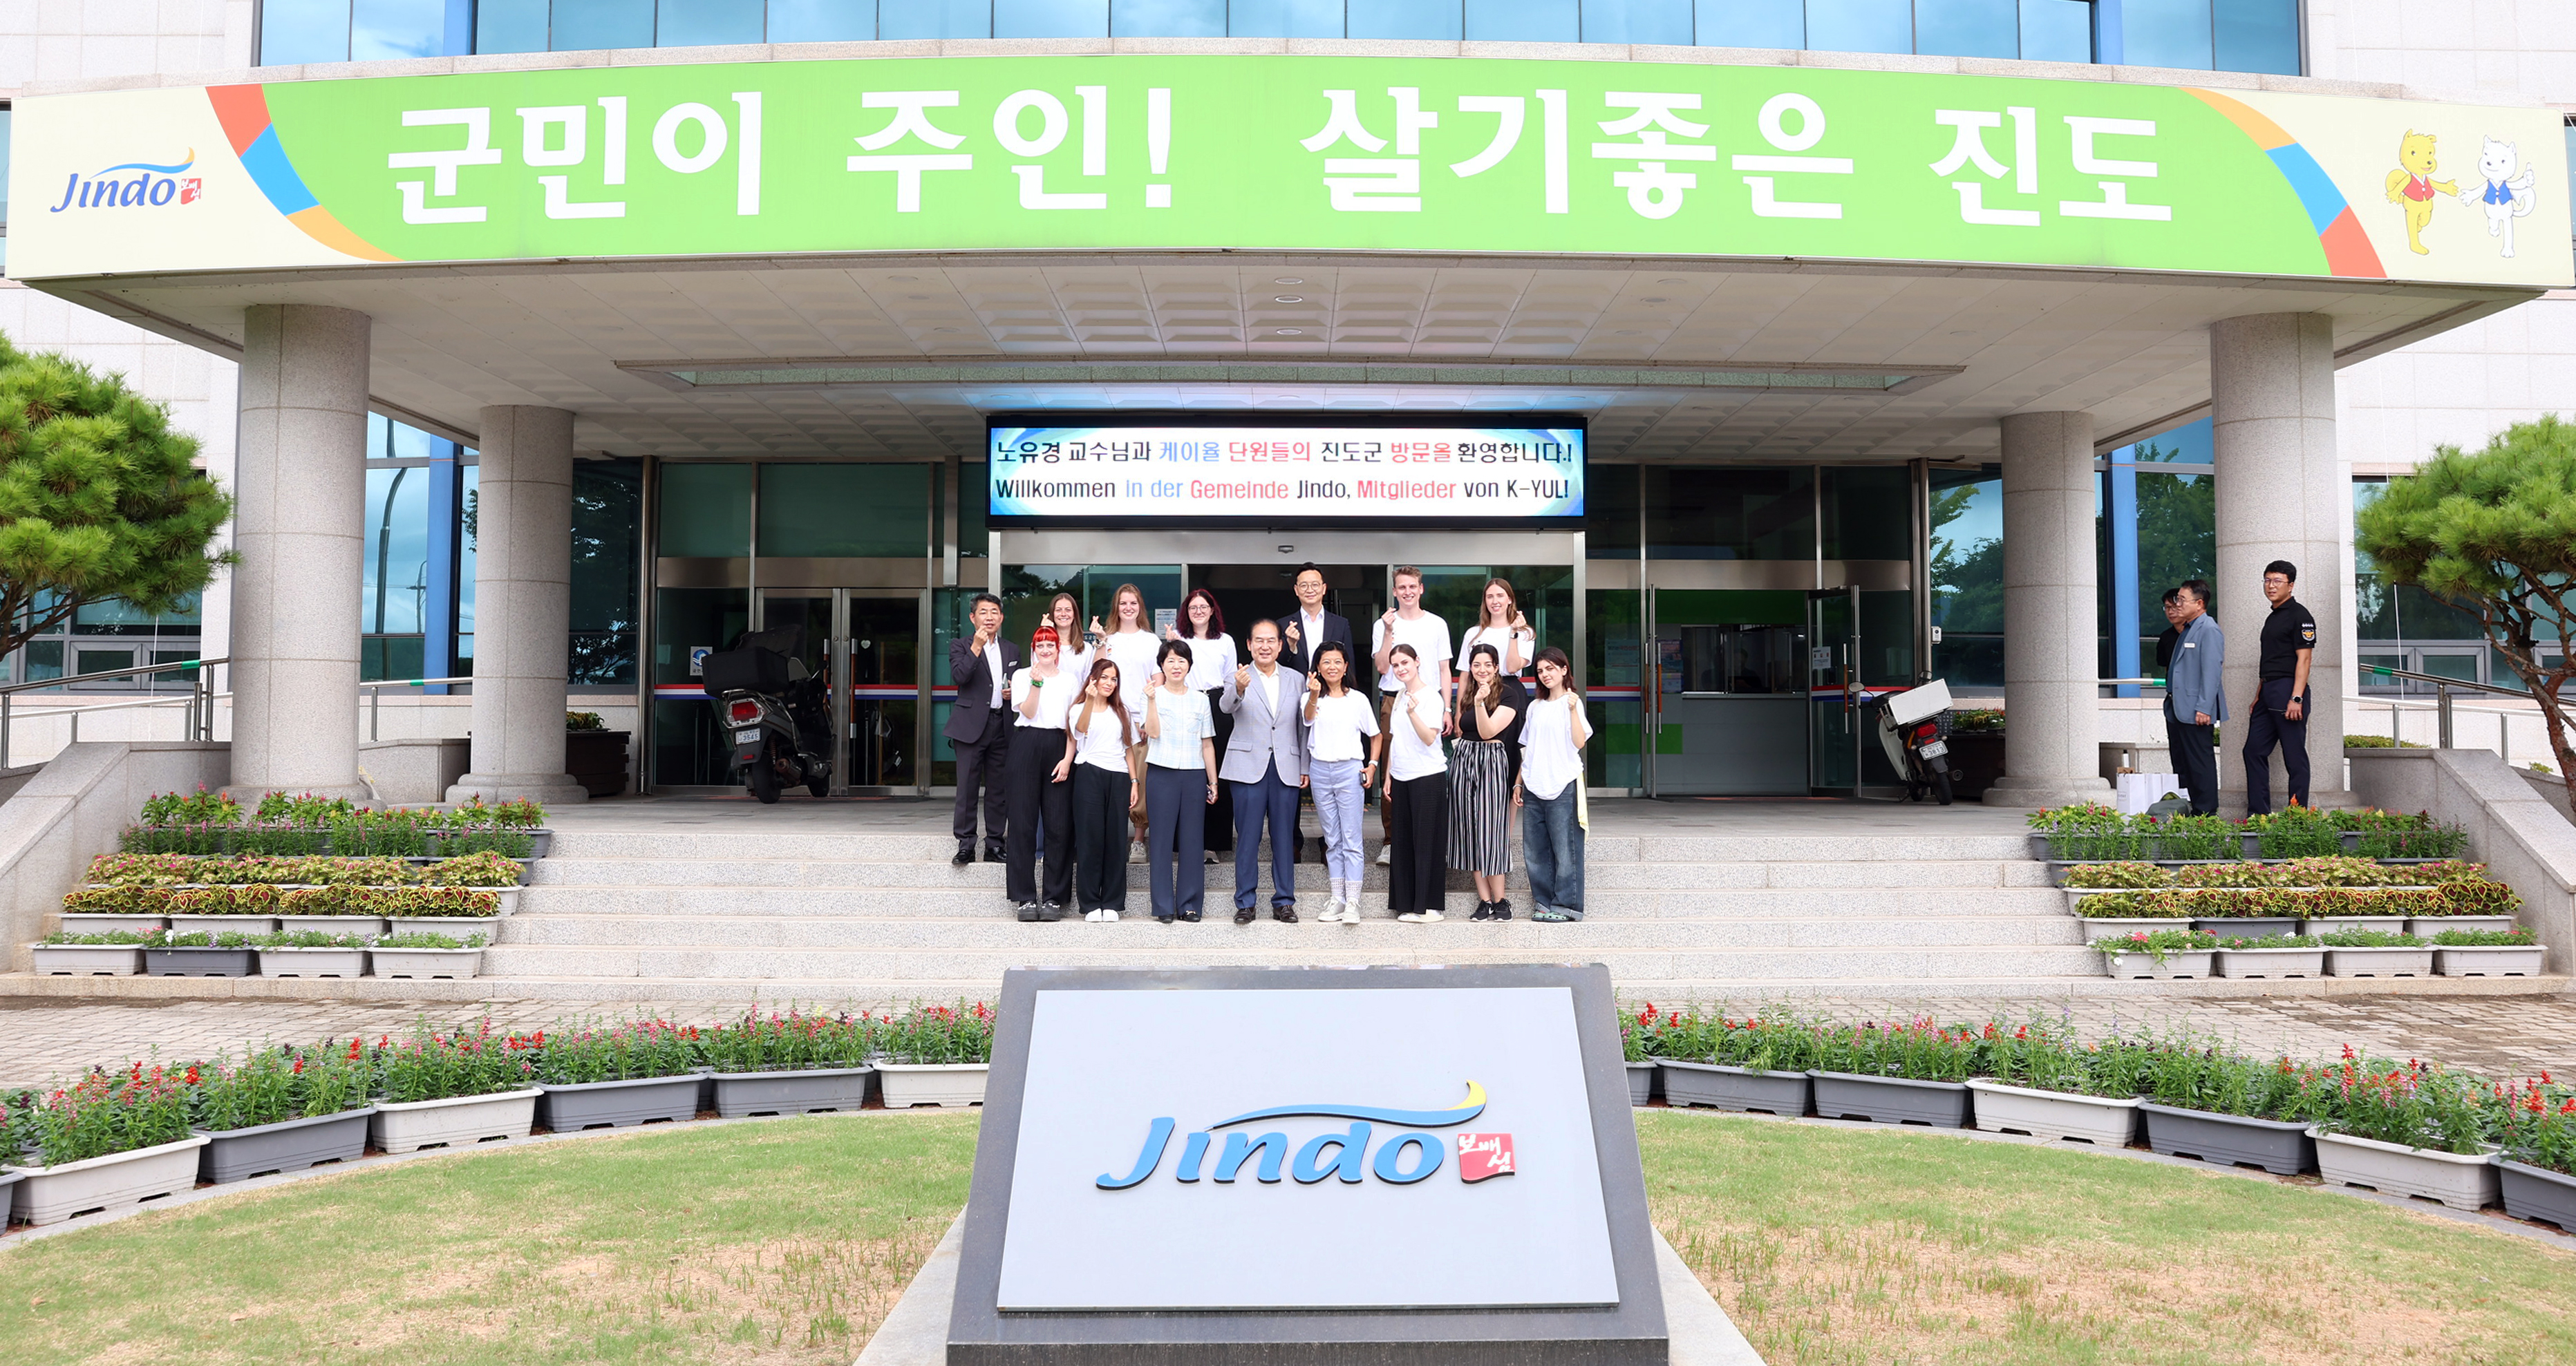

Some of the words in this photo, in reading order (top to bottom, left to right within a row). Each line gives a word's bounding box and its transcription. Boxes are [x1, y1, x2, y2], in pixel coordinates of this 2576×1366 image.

[388, 91, 762, 225] 군민이
[847, 84, 1172, 213] 주인!
[1299, 86, 1854, 220] 살기좋은
[1928, 105, 2172, 227] 진도
[50, 173, 176, 213] Jindo
[997, 442, 1060, 464] 노유경
[1069, 441, 1151, 462] 교수님과
[1159, 442, 1219, 462] 케이율
[1229, 442, 1310, 462] 단원들의
[1321, 442, 1382, 462] 진도군
[995, 479, 1116, 498] Willkommen
[1126, 480, 1143, 497] in
[1151, 480, 1183, 497] der
[1191, 480, 1289, 499] Gemeinde
[1297, 480, 1351, 500] Jindo,
[1357, 480, 1457, 500] Mitglieder
[1464, 482, 1499, 498] von
[1507, 480, 1569, 499] K-YUL!
[1096, 1117, 1445, 1191] Jindo
